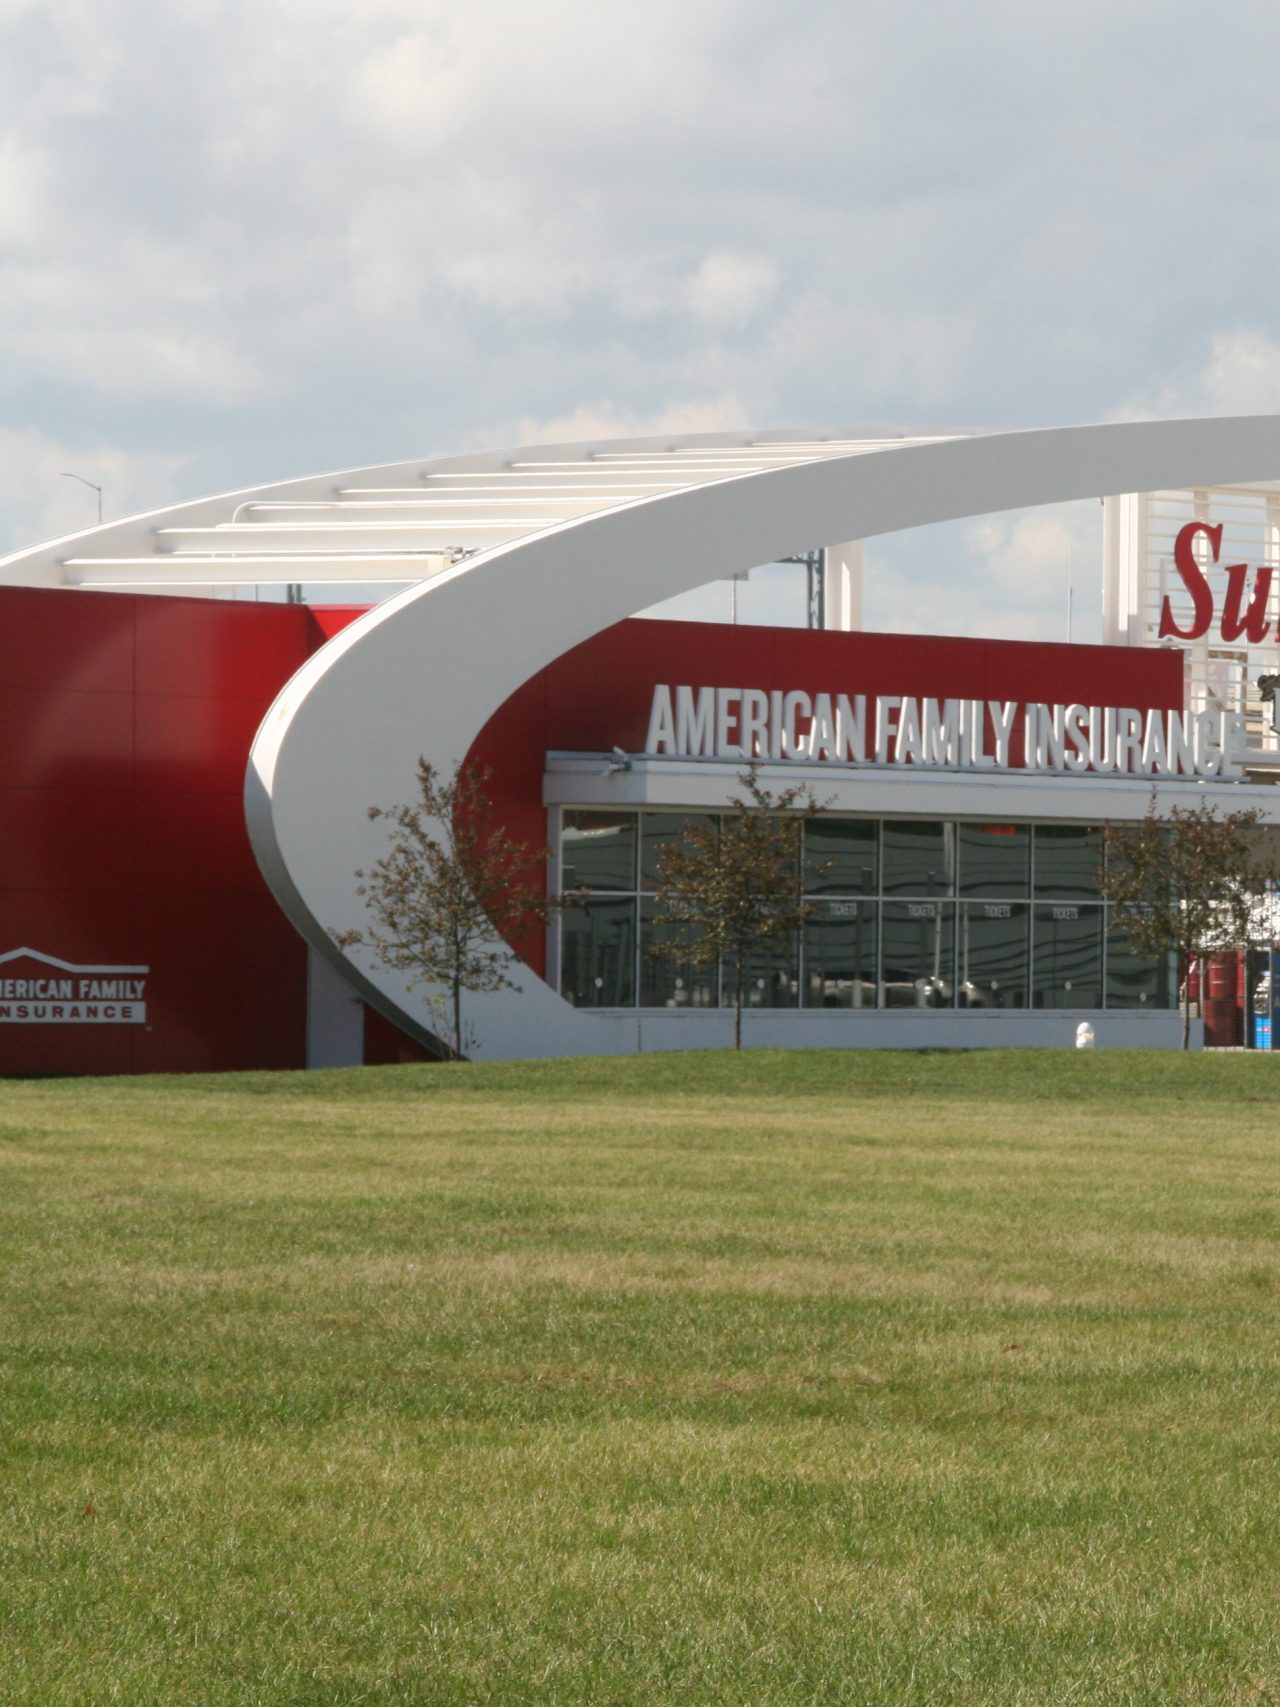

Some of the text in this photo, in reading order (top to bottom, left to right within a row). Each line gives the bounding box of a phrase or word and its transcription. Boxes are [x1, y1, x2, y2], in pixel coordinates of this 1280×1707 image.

[645, 684, 1246, 777] AMERICAN FAMILY INSURANCE
[0, 979, 146, 999] ERICAN FAMILY
[0, 1005, 133, 1019] NSURANCE
